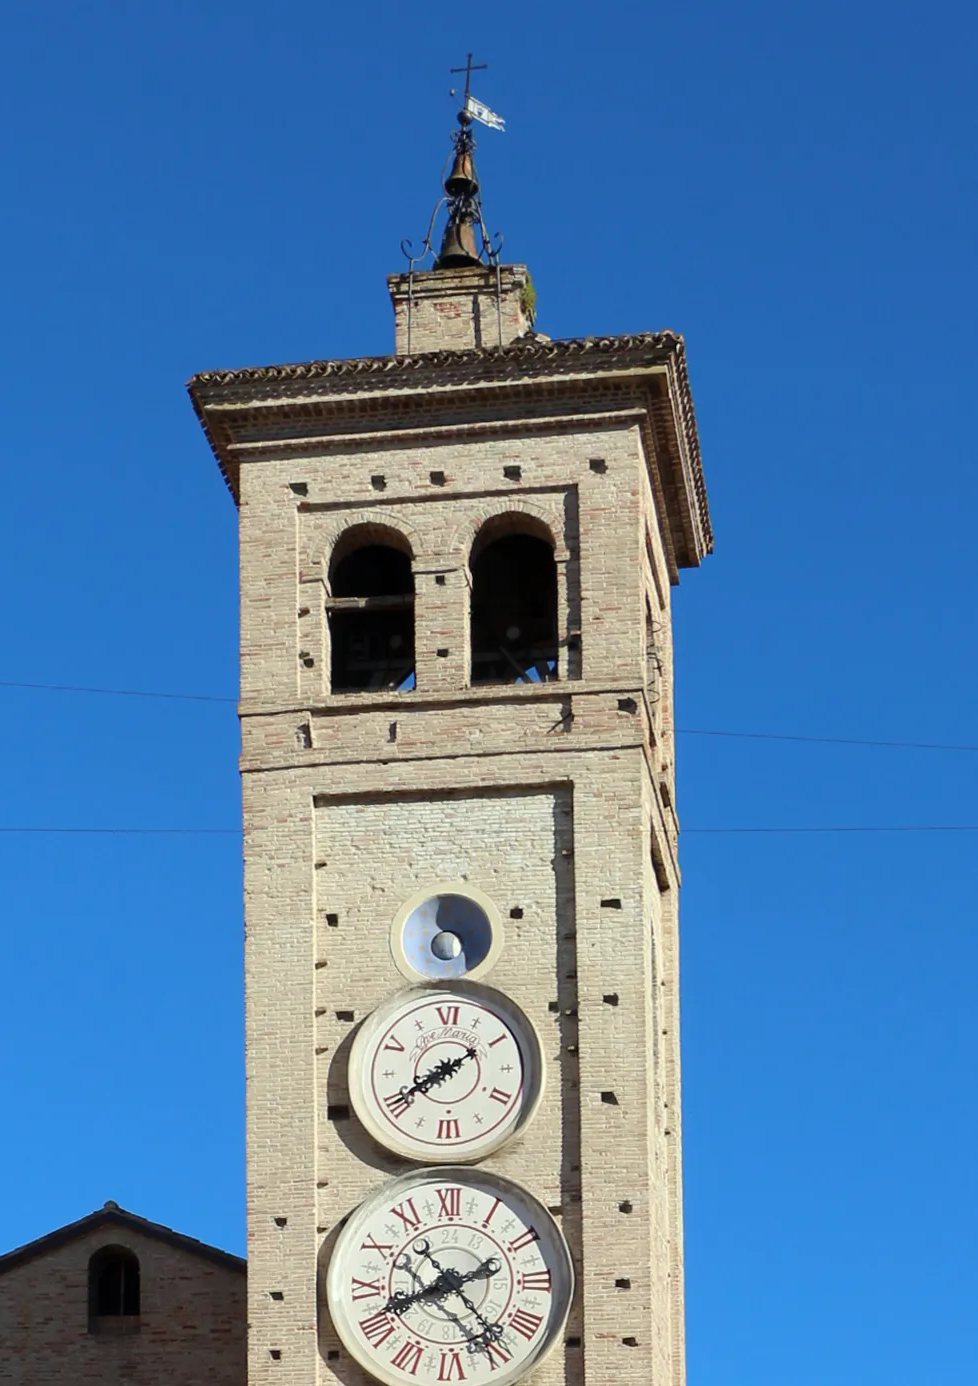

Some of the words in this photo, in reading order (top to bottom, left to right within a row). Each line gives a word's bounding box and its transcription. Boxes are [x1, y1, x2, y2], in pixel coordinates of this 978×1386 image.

[435, 1006, 460, 1025] VI
[384, 1035, 405, 1053] V
[441, 1027, 478, 1044] Maria
[488, 1033, 507, 1048] I
[489, 1087, 512, 1106] II
[437, 1118, 461, 1139] III
[437, 1188, 462, 1217] XII
[483, 1198, 503, 1226] I
[391, 1197, 422, 1233] XI
[361, 1232, 393, 1261] X
[441, 1229, 458, 1244] 24
[467, 1233, 483, 1250] 13
[509, 1225, 541, 1253] II
[351, 1276, 380, 1302] IX
[493, 1277, 508, 1291] 15
[522, 1269, 552, 1293] III
[484, 1300, 502, 1317] 16
[359, 1311, 396, 1349] VIII
[417, 1319, 435, 1336] 19
[508, 1308, 544, 1342] IIII
[390, 1341, 425, 1376] VII
[437, 1352, 467, 1381] VI
